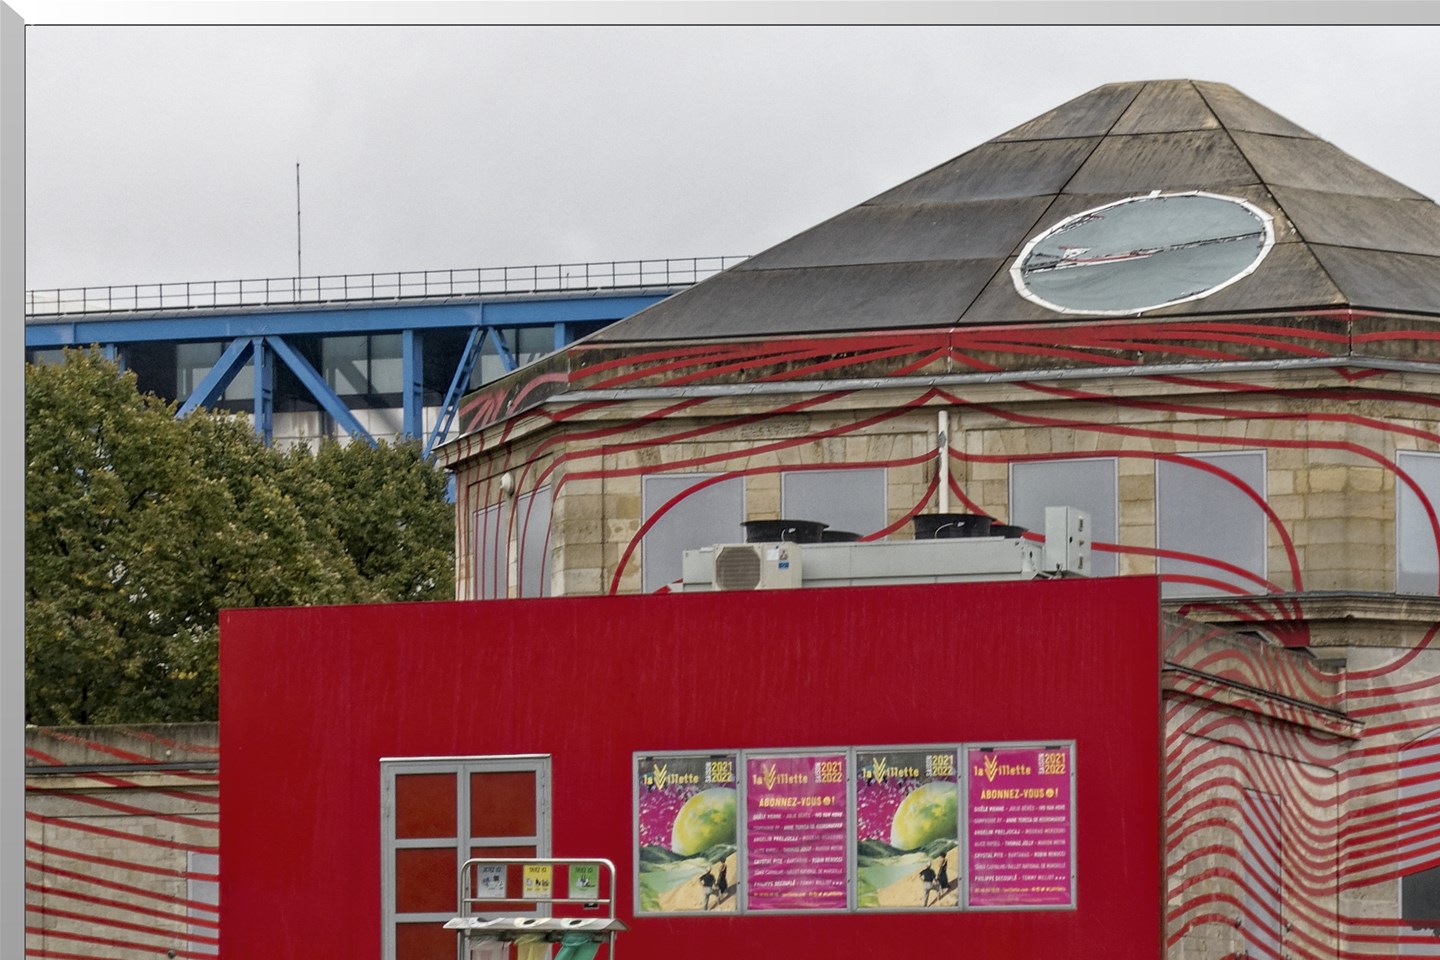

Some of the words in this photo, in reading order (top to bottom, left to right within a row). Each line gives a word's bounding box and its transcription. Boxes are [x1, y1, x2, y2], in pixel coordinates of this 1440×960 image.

[932, 755, 953, 766] 2021
[1044, 752, 1066, 764] 2021
[712, 762, 732, 772] 2021
[822, 761, 842, 772] 2021
[932, 765, 953, 777] 2022
[974, 765, 983, 777] la
[1044, 764, 1066, 775] 2022
[712, 772, 732, 783] 2022
[822, 772, 842, 783] 2022
[862, 767, 872, 779] la
[644, 774, 653, 785] la
[752, 774, 762, 785] la
[981, 788, 1044, 800] ABONNEZ-VOUS
[759, 796, 822, 808] ABONNEZ-VOUS
